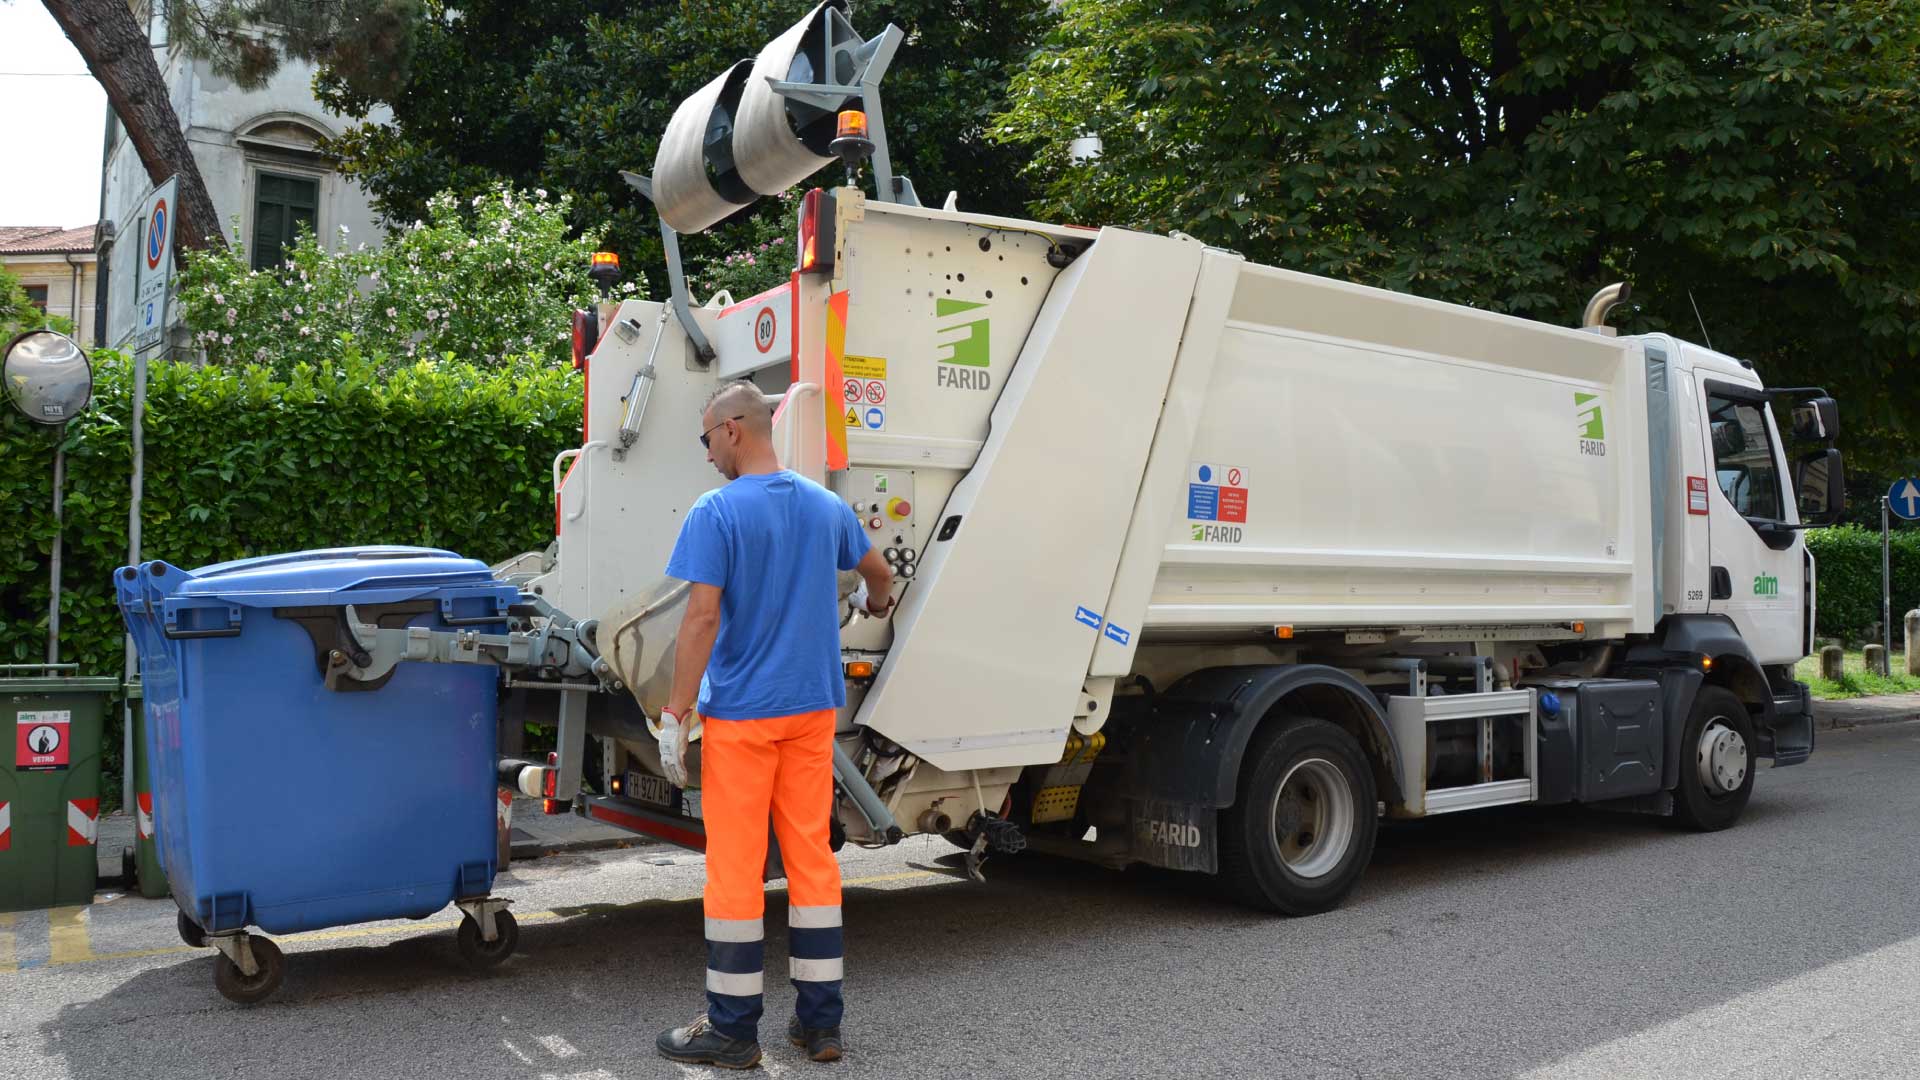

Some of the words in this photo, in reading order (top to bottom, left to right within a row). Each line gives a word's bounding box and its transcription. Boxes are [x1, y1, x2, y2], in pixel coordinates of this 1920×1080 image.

[760, 320, 771, 340] 80
[937, 366, 991, 391] FARID
[1580, 440, 1606, 457] FARID
[1204, 525, 1242, 544] FARID
[1753, 570, 1778, 595] aim
[1688, 590, 1703, 601] 5269
[19, 713, 37, 721] aim
[629, 773, 640, 797] FH
[641, 776, 658, 802] 927
[658, 780, 670, 804] AH
[1150, 820, 1201, 848] FARID
